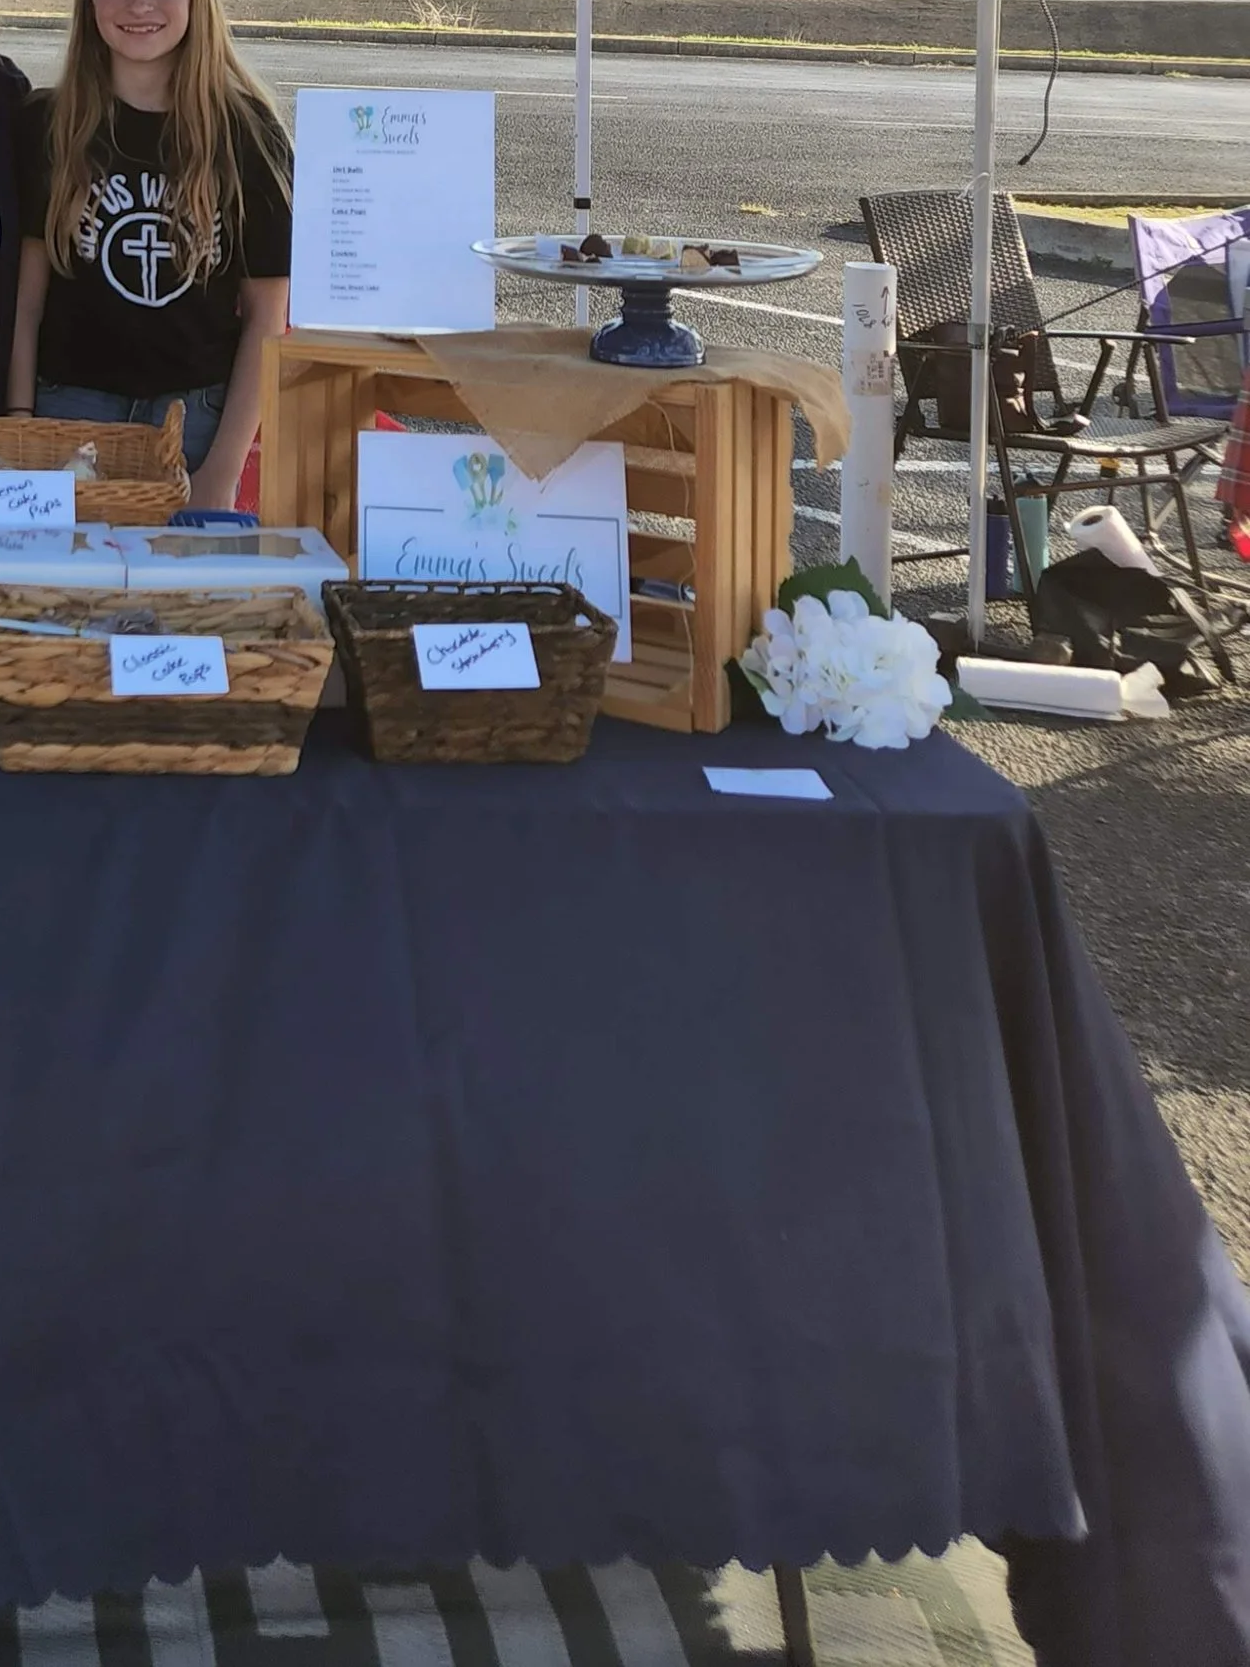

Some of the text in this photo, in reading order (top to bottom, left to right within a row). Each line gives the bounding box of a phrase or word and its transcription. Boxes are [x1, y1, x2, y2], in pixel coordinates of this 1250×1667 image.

[382, 106, 427, 125] Emma's
[382, 125, 420, 144] Sweets
[395, 537, 584, 590] Emma's Sweets
